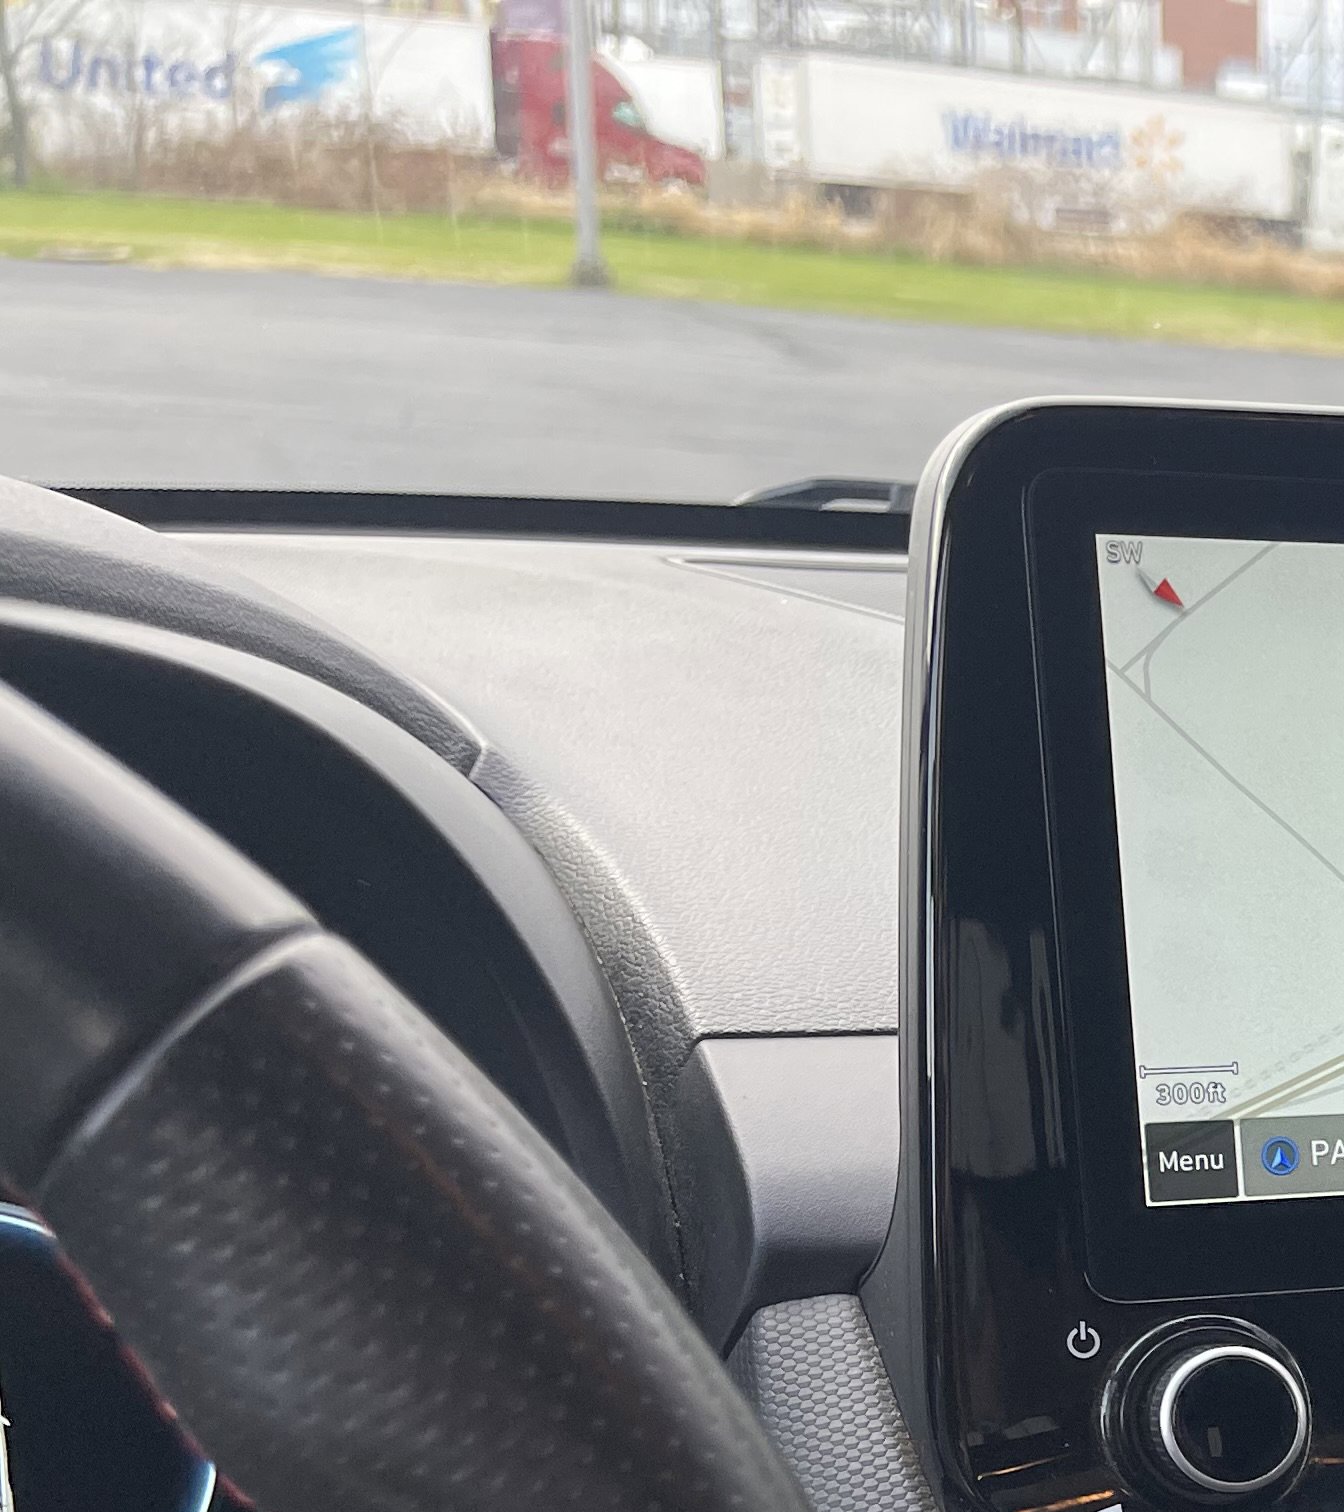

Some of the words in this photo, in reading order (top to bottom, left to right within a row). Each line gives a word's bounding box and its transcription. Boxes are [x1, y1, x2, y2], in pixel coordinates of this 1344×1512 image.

[1105, 540, 1144, 565] SW
[1156, 1082, 1227, 1106] 300ft
[1158, 1150, 1224, 1173] Menu
